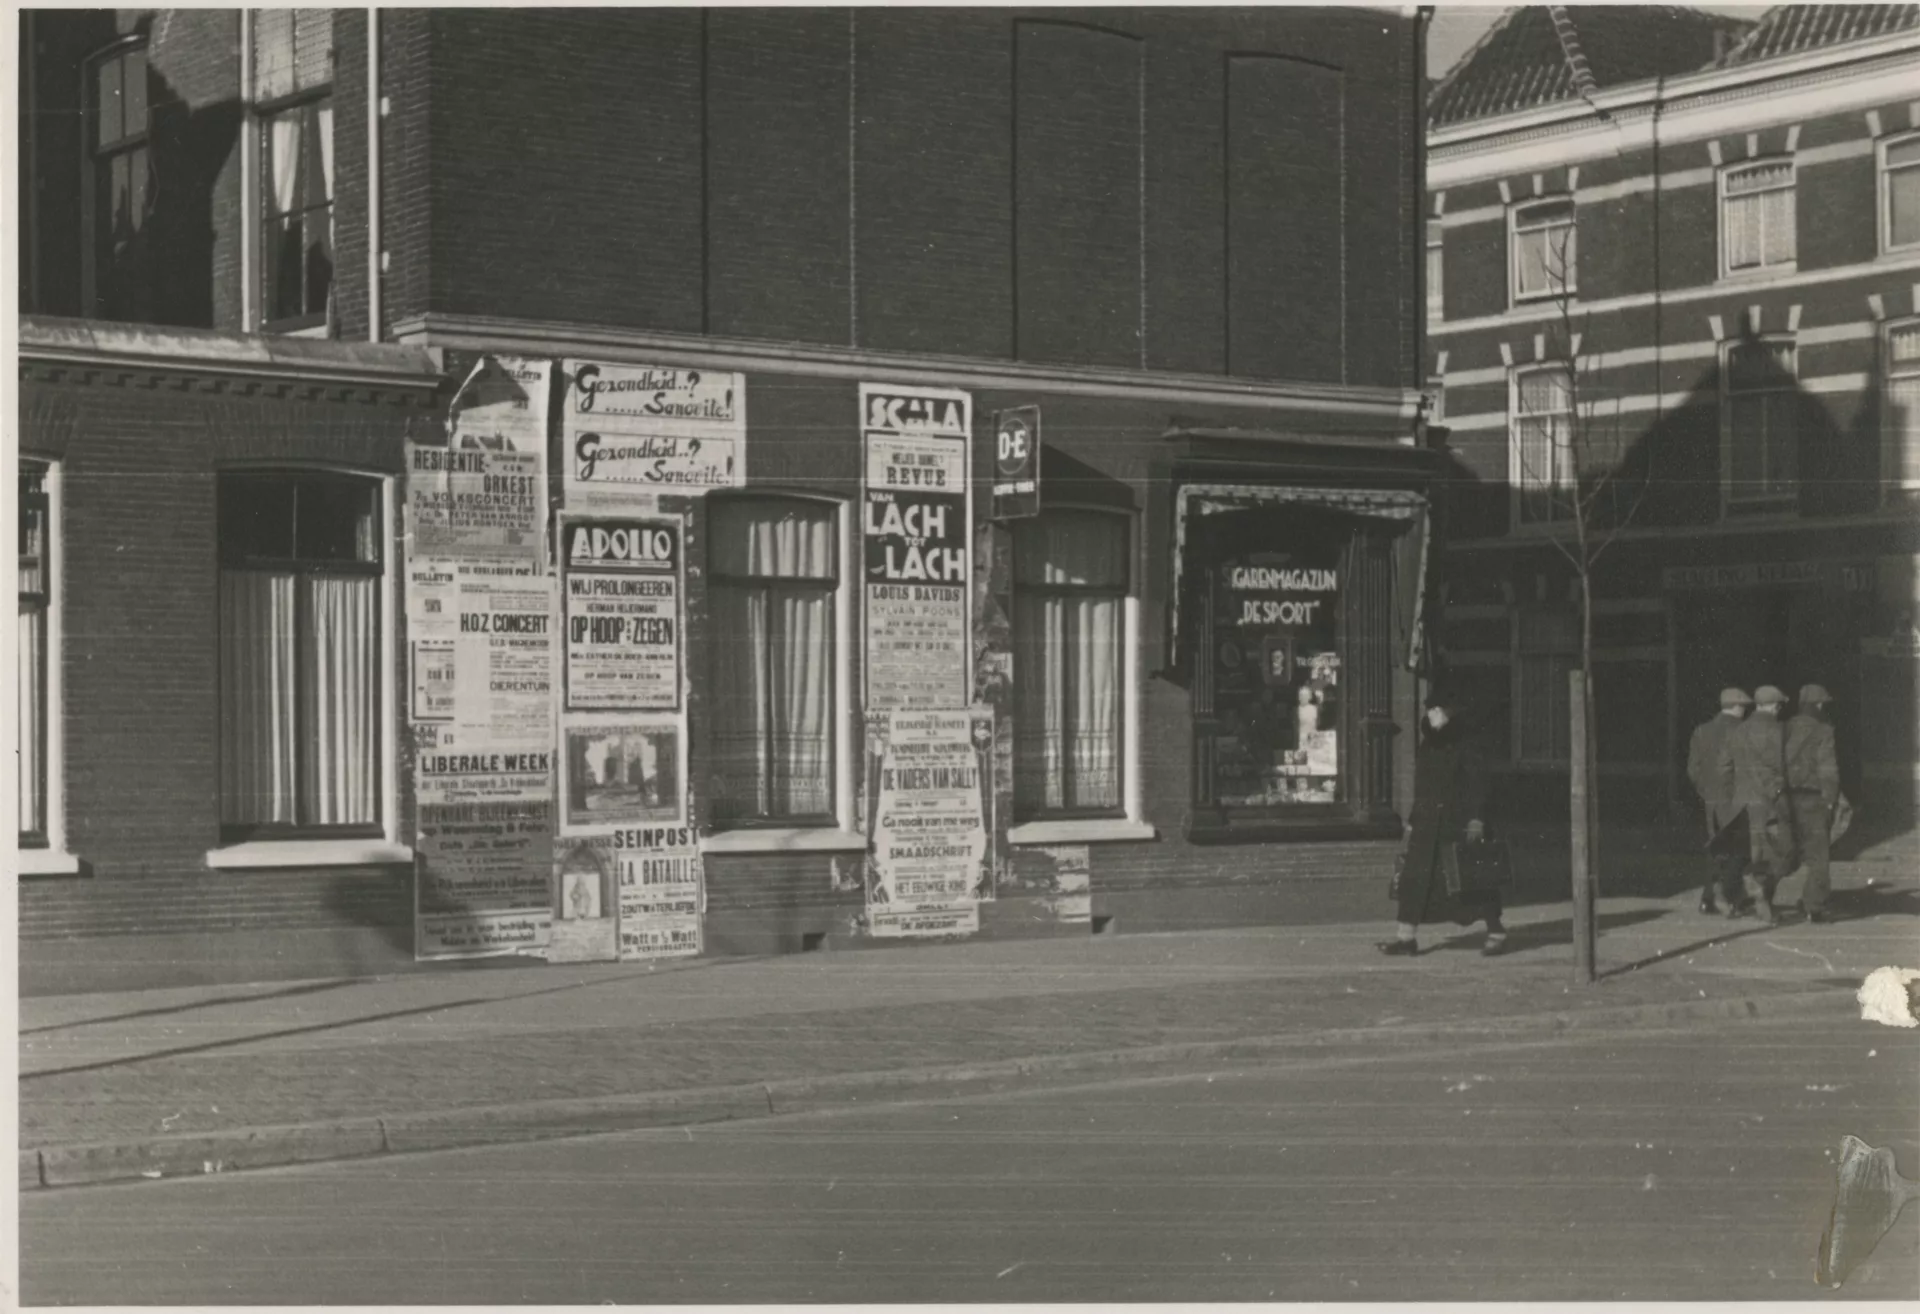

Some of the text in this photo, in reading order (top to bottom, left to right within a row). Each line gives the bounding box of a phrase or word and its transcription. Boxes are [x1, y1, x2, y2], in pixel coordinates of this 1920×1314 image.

[871, 398, 962, 433] SCALA
[483, 473, 535, 495] ORKEST
[886, 467, 947, 488] REVUE
[869, 491, 895, 502] VAN
[866, 501, 945, 538] LACH
[571, 527, 672, 560] APOLLO
[905, 536, 928, 548] TOT
[886, 544, 965, 580] LACH
[570, 579, 673, 597] WIJ PROLONGEEREN
[872, 586, 961, 602] LOUIS DAVIDS
[492, 614, 549, 633] CONCERT
[571, 616, 589, 644] OP
[590, 616, 625, 644] HOOP
[632, 616, 673, 645] ZEGEN
[490, 680, 550, 692] DIERENTUIN
[422, 753, 548, 773] LIBERALE WEEK
[614, 827, 697, 849] SEINPOST
[890, 845, 972, 859] SMAADSCHRIFT
[621, 858, 696, 886] LA BATAILLE
